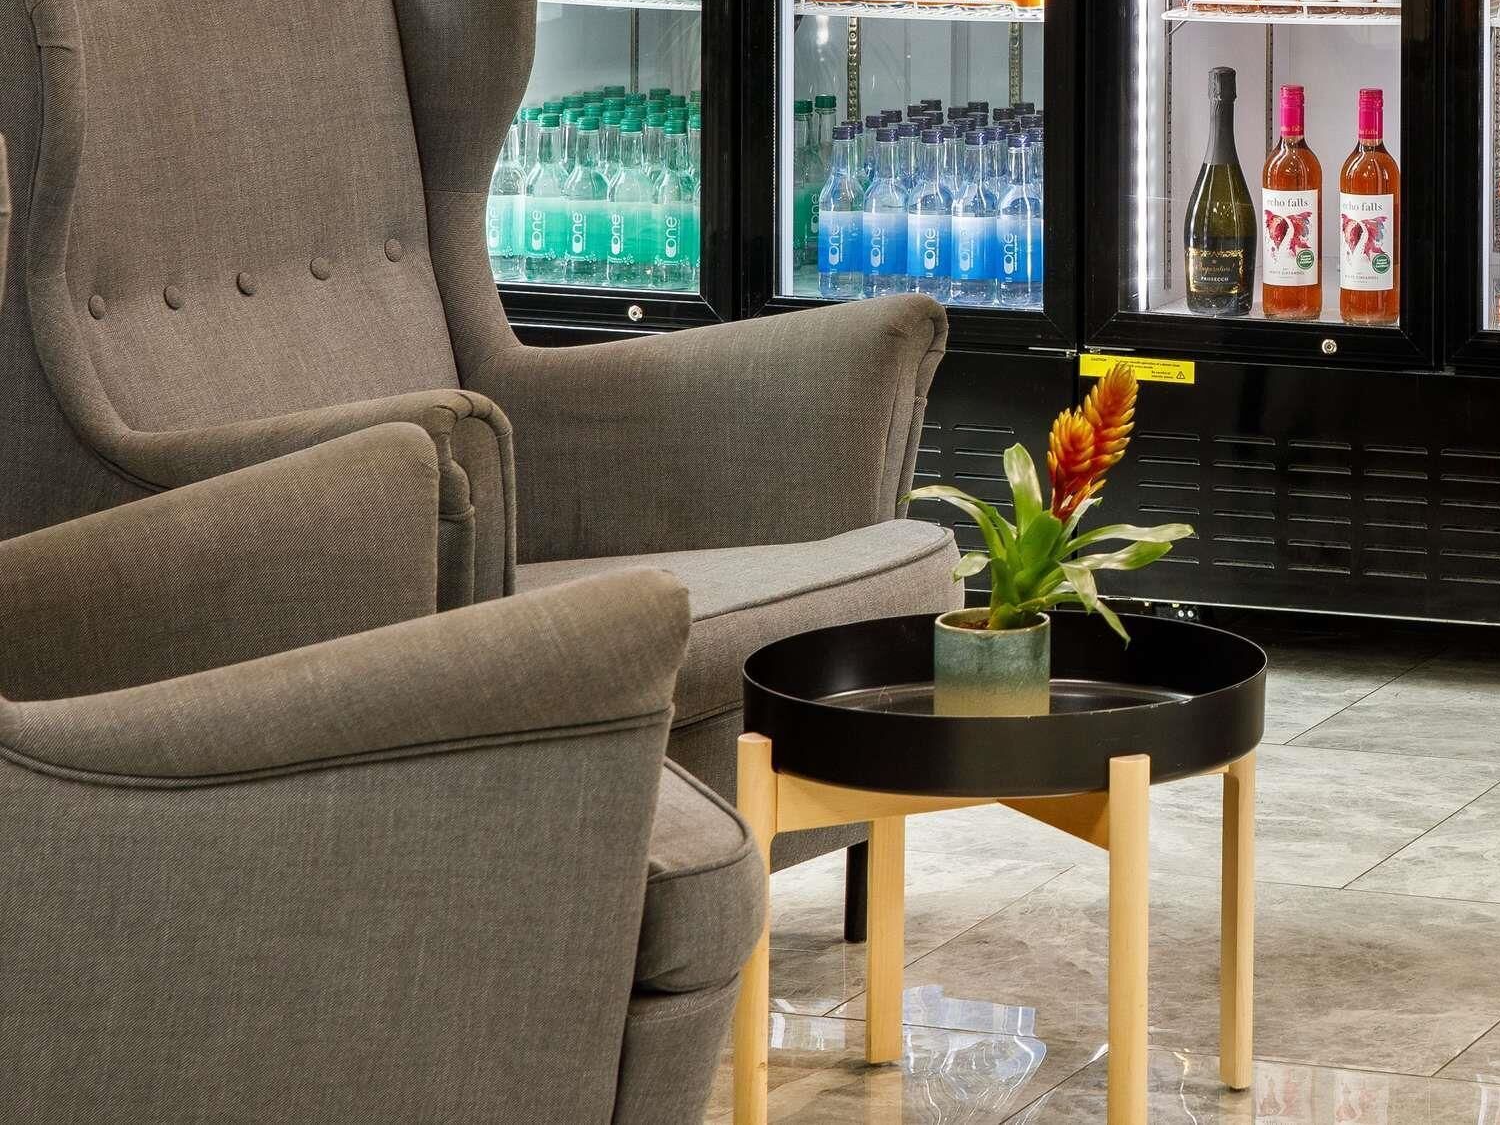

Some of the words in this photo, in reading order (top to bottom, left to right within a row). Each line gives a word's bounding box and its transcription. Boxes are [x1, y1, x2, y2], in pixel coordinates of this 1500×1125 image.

[1287, 198, 1308, 207] falls
[1361, 202, 1383, 211] falls
[572, 211, 583, 254] one
[611, 213, 622, 255] one
[665, 216, 677, 257] one
[924, 228, 936, 270] one
[1003, 233, 1014, 275] one
